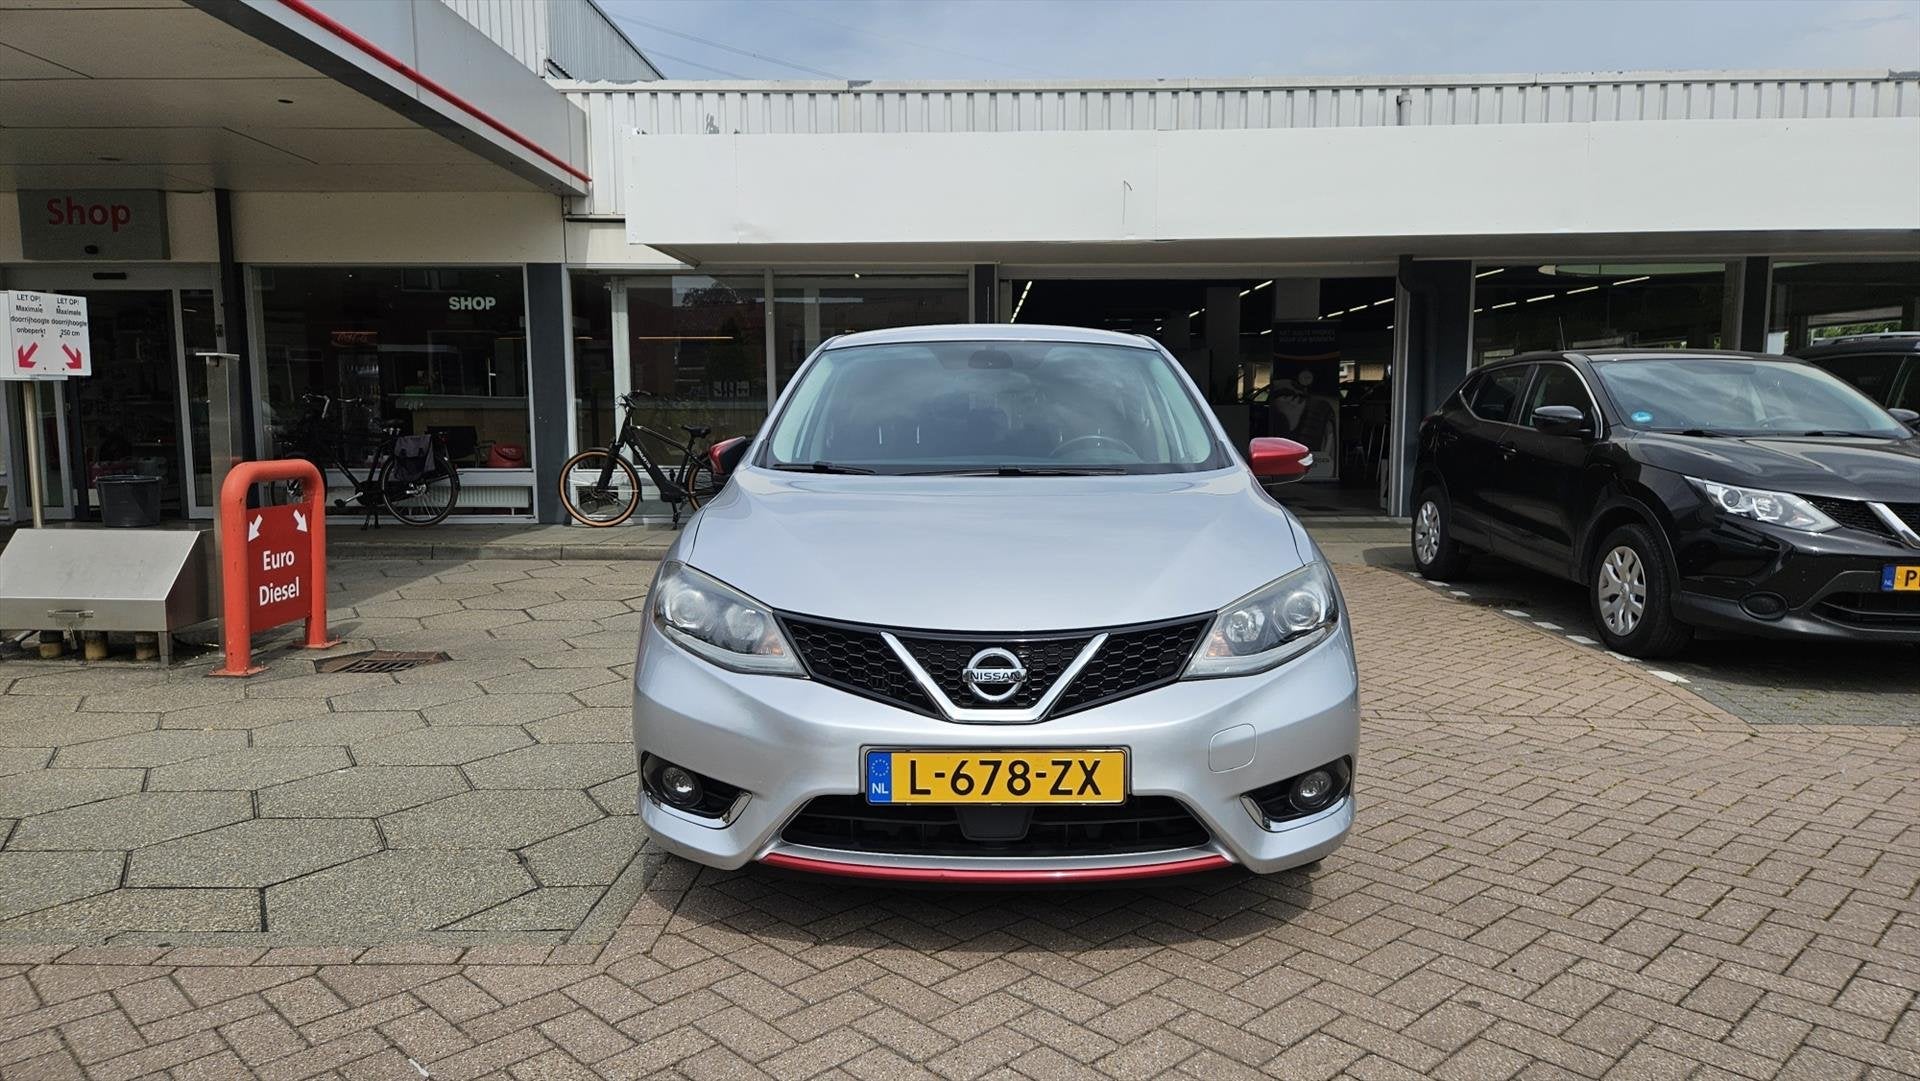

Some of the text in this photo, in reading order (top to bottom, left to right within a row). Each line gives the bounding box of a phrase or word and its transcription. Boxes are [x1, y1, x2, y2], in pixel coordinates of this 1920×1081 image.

[46, 196, 131, 232] Shop
[16, 293, 41, 302] LET OP!
[69, 298, 80, 306] OP!
[16, 304, 44, 313] Maximale
[448, 296, 496, 311] SHOP
[56, 307, 82, 316] Maximale
[10, 315, 50, 325] doorrijhoogte
[60, 328, 71, 336] 250
[263, 550, 295, 571] Euro
[1883, 579, 1893, 587] NL
[1905, 569, 1920, 587] P
[259, 577, 300, 606] Diesel
[970, 671, 1021, 681] NISSAN
[909, 760, 1101, 796] L-678-ZX
[872, 783, 888, 794] NL
